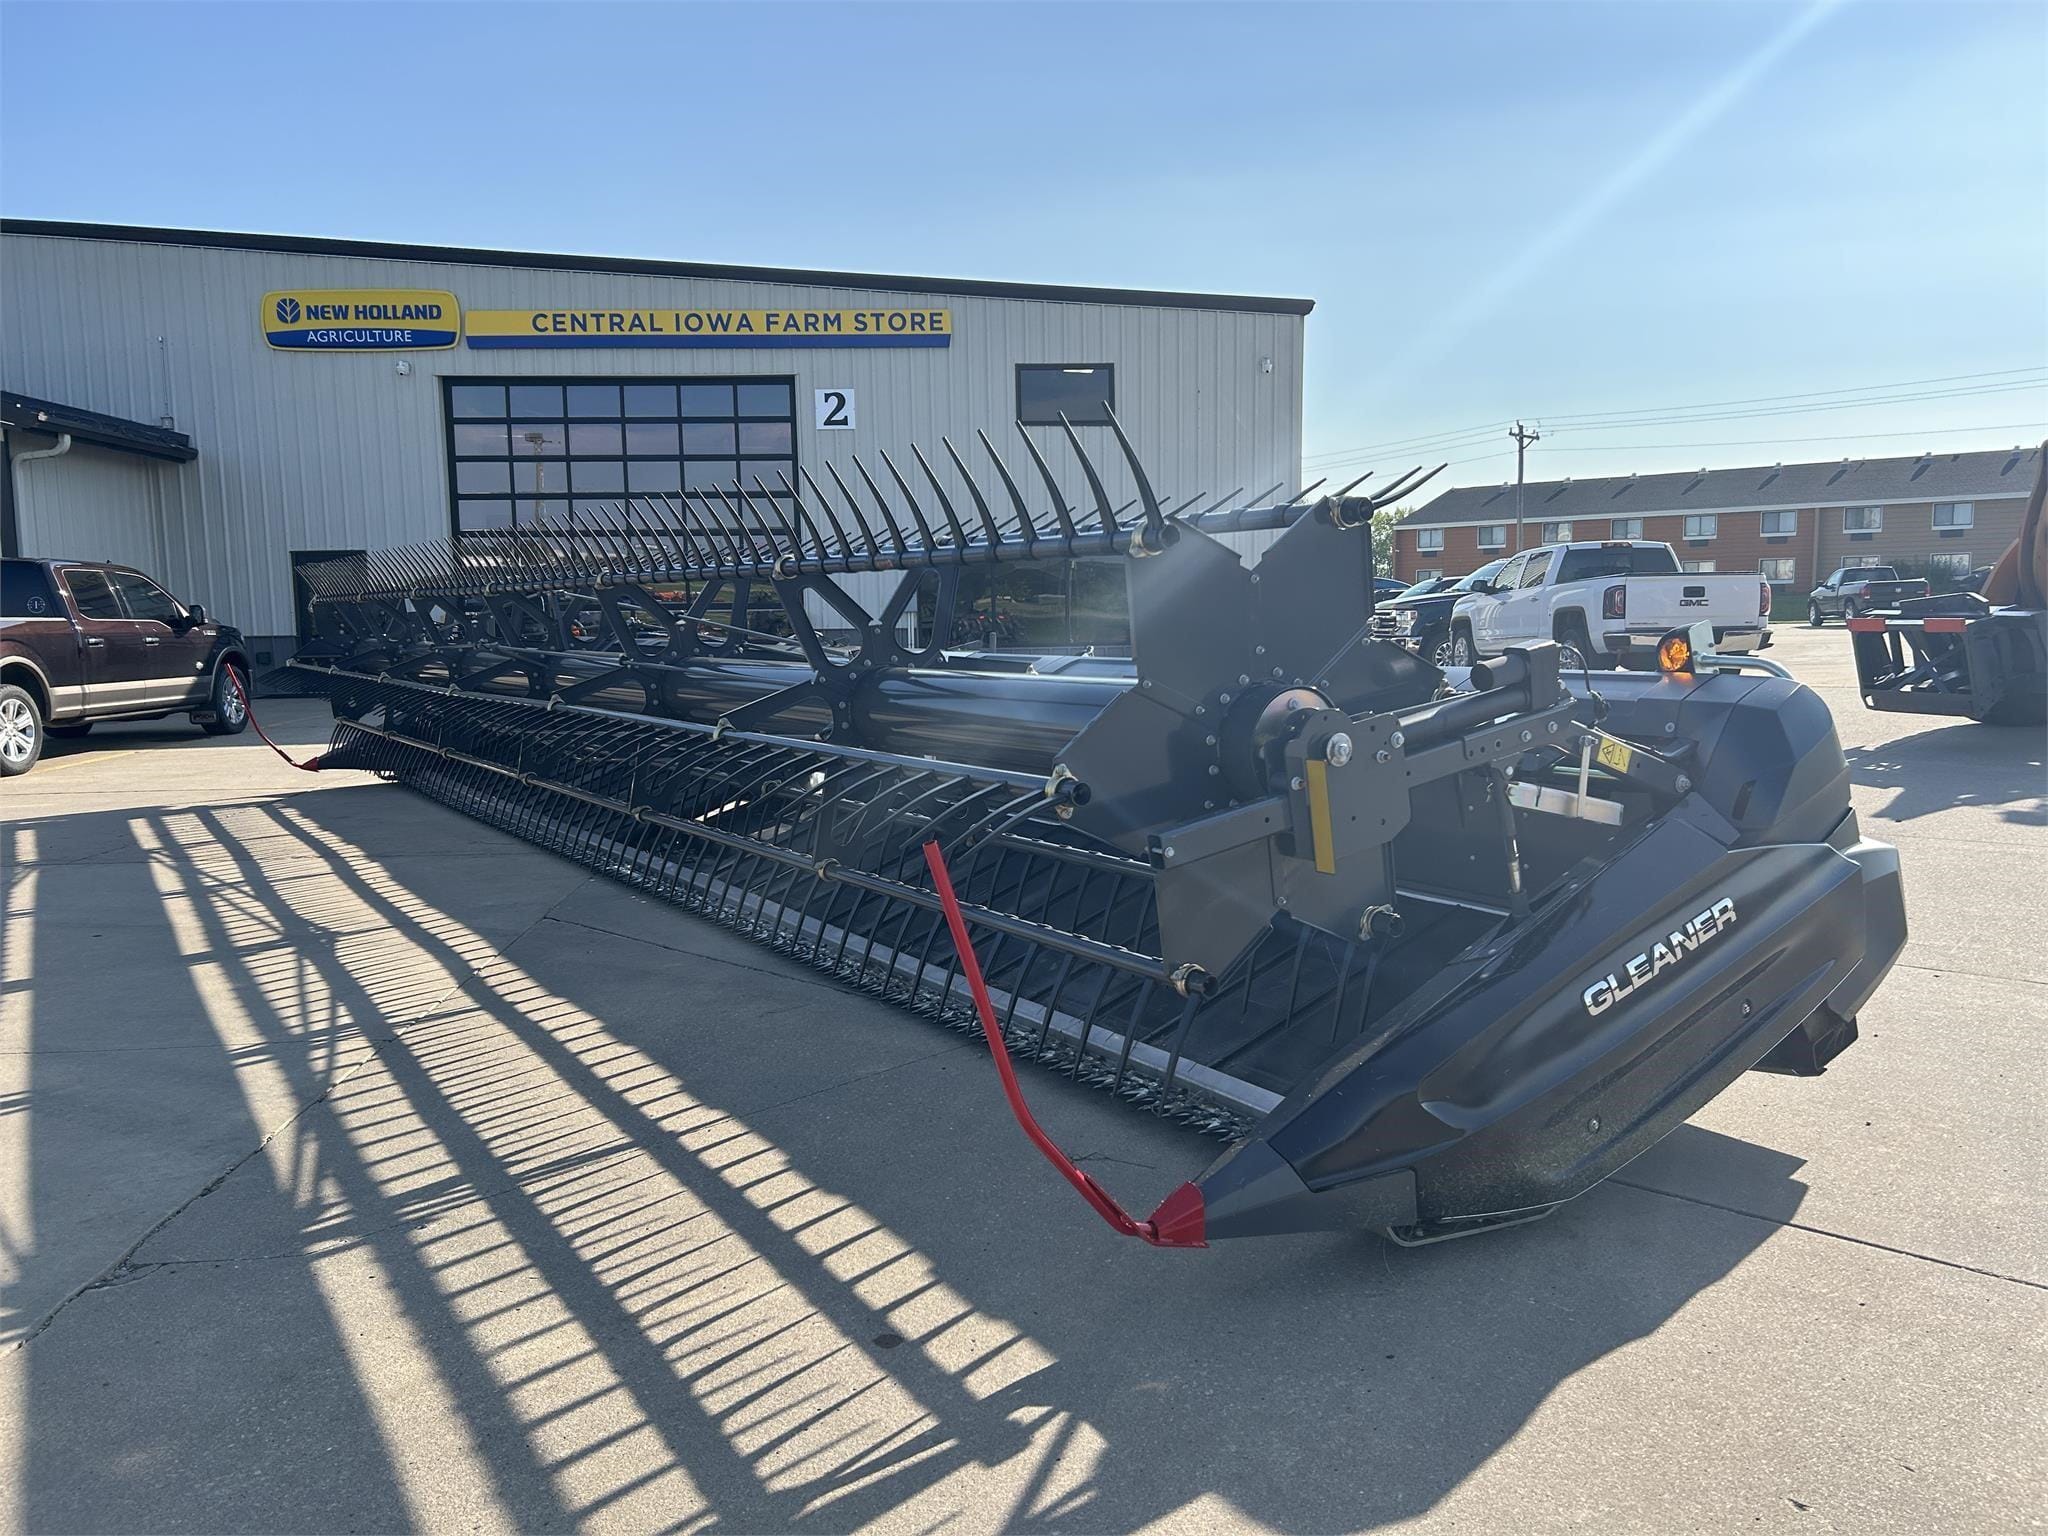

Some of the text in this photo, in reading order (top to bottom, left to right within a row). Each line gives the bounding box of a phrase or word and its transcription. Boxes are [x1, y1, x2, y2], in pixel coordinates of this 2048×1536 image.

[306, 304, 442, 320] NEW HOLLAND
[531, 312, 944, 333] CENTRAL IOWA FARM STORE
[307, 330, 412, 343] AGRICULTURE
[823, 392, 849, 426] 2
[1679, 599, 1709, 607] GMC
[1582, 897, 1737, 1017] GLEANER
